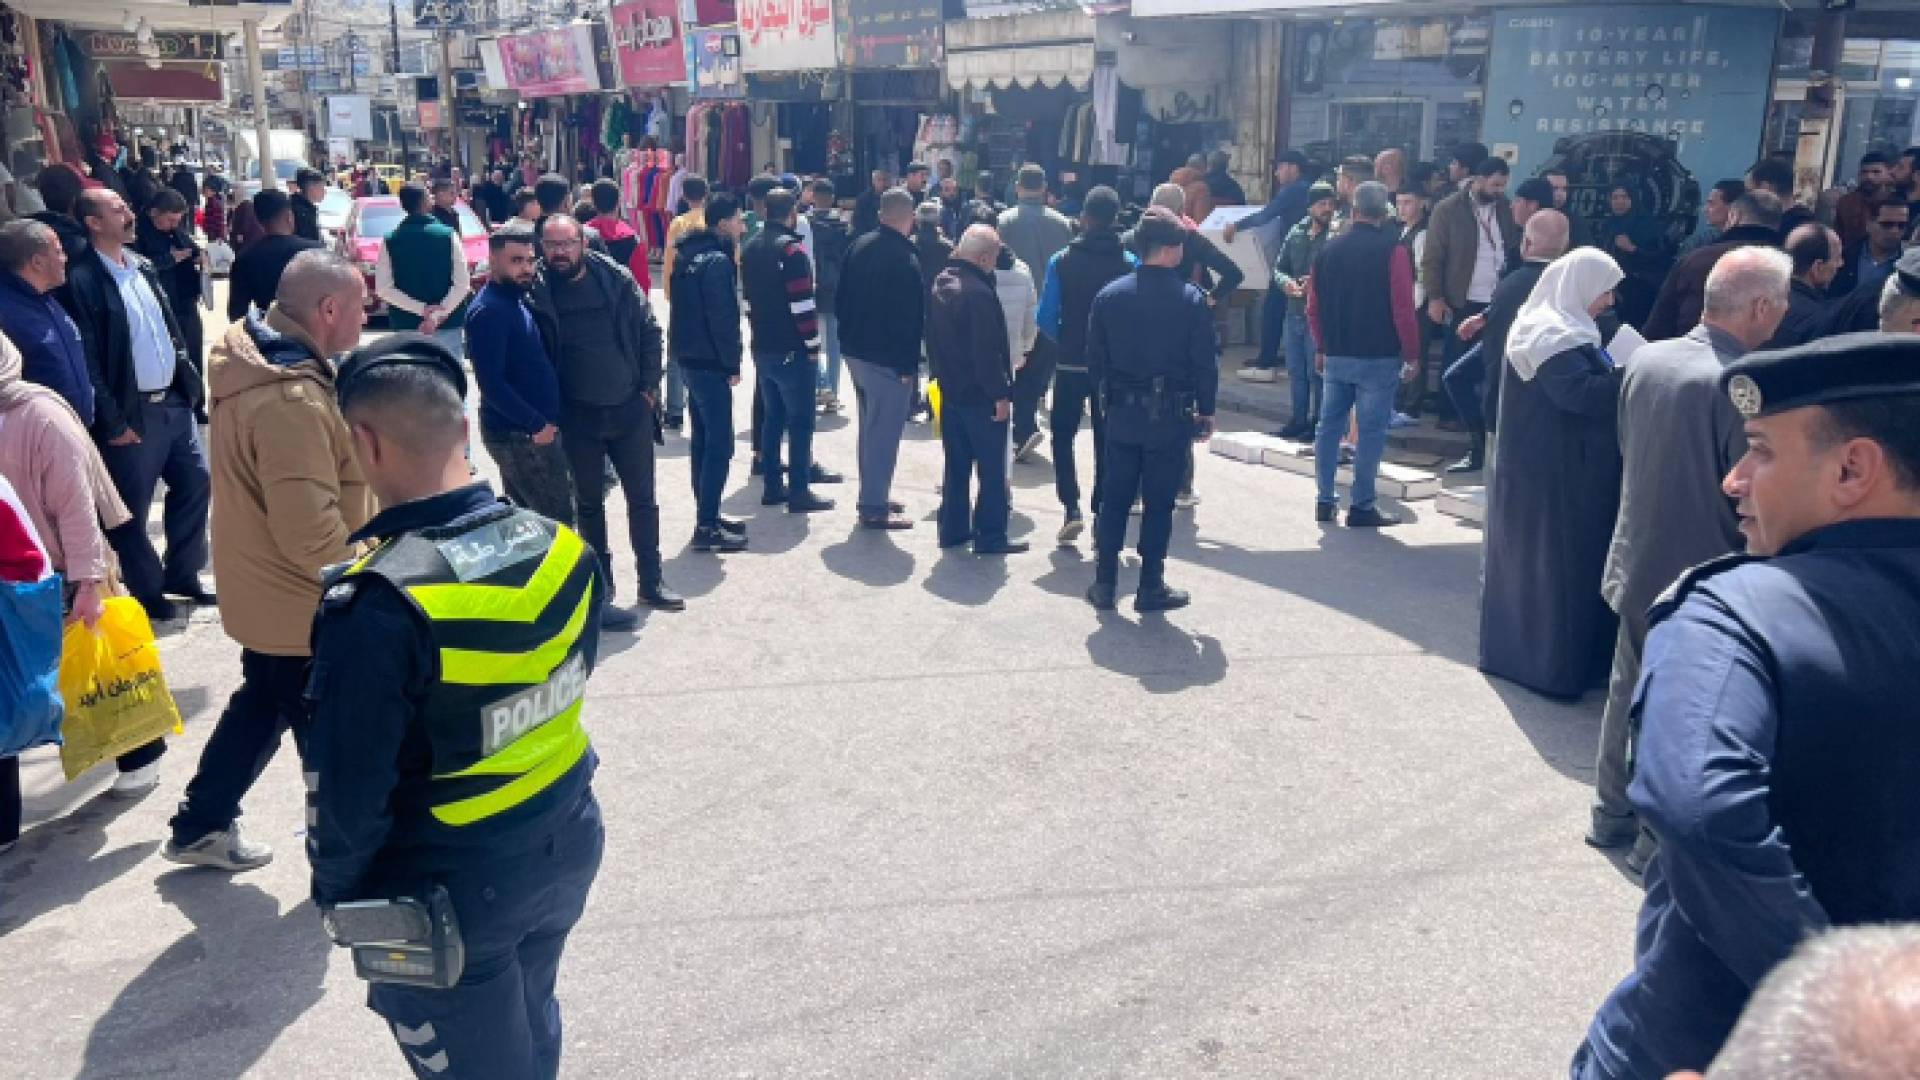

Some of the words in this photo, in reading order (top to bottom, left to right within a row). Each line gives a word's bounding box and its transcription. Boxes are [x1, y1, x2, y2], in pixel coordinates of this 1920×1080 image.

[1577, 27, 1687, 42] 10-YEAR
[1530, 50, 1649, 66] BATTERY
[1663, 50, 1729, 68] LIFE,
[1576, 96, 1668, 111] WATER
[1535, 118, 1705, 133] RESISTANCE
[448, 521, 549, 564] الشرطة
[491, 653, 585, 747] POLICE
